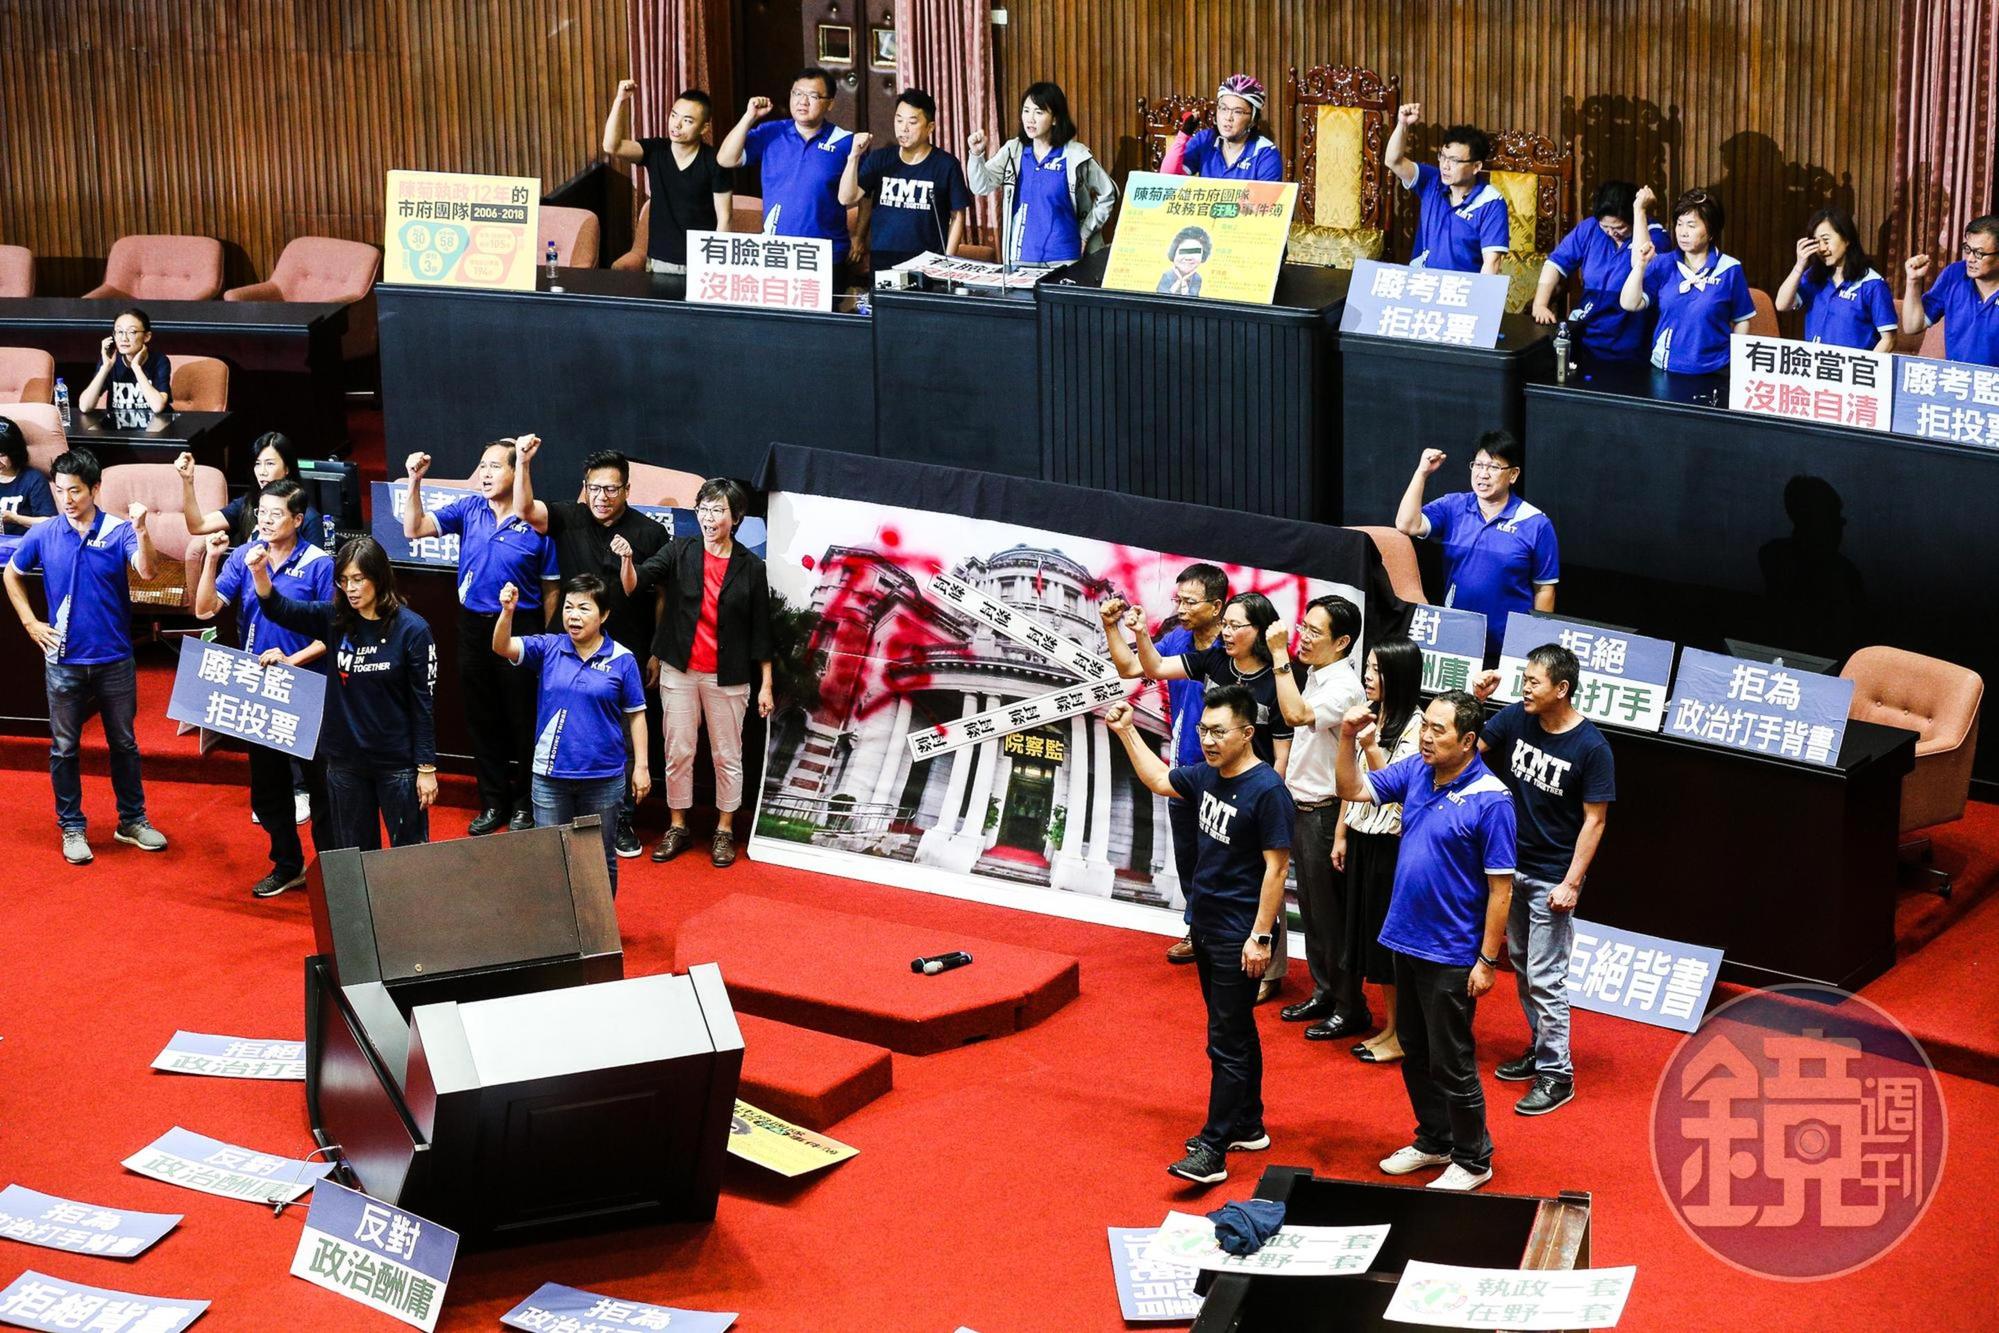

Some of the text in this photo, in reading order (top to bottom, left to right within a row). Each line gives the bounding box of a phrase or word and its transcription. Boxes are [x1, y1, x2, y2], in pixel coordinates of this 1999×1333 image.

[818, 142, 836, 153] KMT
[399, 181, 529, 204] 陳菊執政12年的
[880, 177, 934, 204] KMT
[1134, 187, 1250, 202] 陳菊高雄市府團隊
[399, 200, 524, 220] 市府團隊 2006-2018
[700, 236, 820, 271] 有臉當官
[700, 272, 820, 308] 沒臉自清
[1371, 268, 1473, 308] 廢考監
[1839, 289, 1857, 300] KMT
[1377, 305, 1478, 345] 拒投票
[1746, 341, 1879, 388] 有臉當官
[113, 381, 152, 404] KM
[1744, 379, 1878, 428] 沒臉自清
[510, 523, 528, 534] KMT
[1497, 523, 1517, 533] KMT
[87, 539, 106, 548] KMT
[285, 568, 305, 578] KMT
[354, 656, 365, 664] IN
[357, 646, 377, 655] LEAN
[1559, 629, 1627, 674] 拒絕
[198, 648, 295, 704] 廢考監
[353, 662, 390, 672] TOGETHER
[428, 644, 437, 696] KMT
[591, 662, 612, 673] KMT
[1727, 664, 1800, 710] 拒為
[204, 691, 300, 748] 拒投票
[1673, 698, 1834, 763] 政治打手背書
[1511, 738, 1571, 787] KMT
[1200, 791, 1238, 835] KMT
[223, 1042, 305, 1060] 拒絕
[203, 1148, 288, 1175] 反對
[354, 1203, 420, 1261] 反對
[1264, 1233, 1378, 1250] 政一套
[309, 1238, 437, 1321] 政治酬庸
[1476, 1278, 1624, 1297] 執政一套
[584, 1298, 671, 1329] 拒為
[1466, 1303, 1615, 1323] 在野一套
